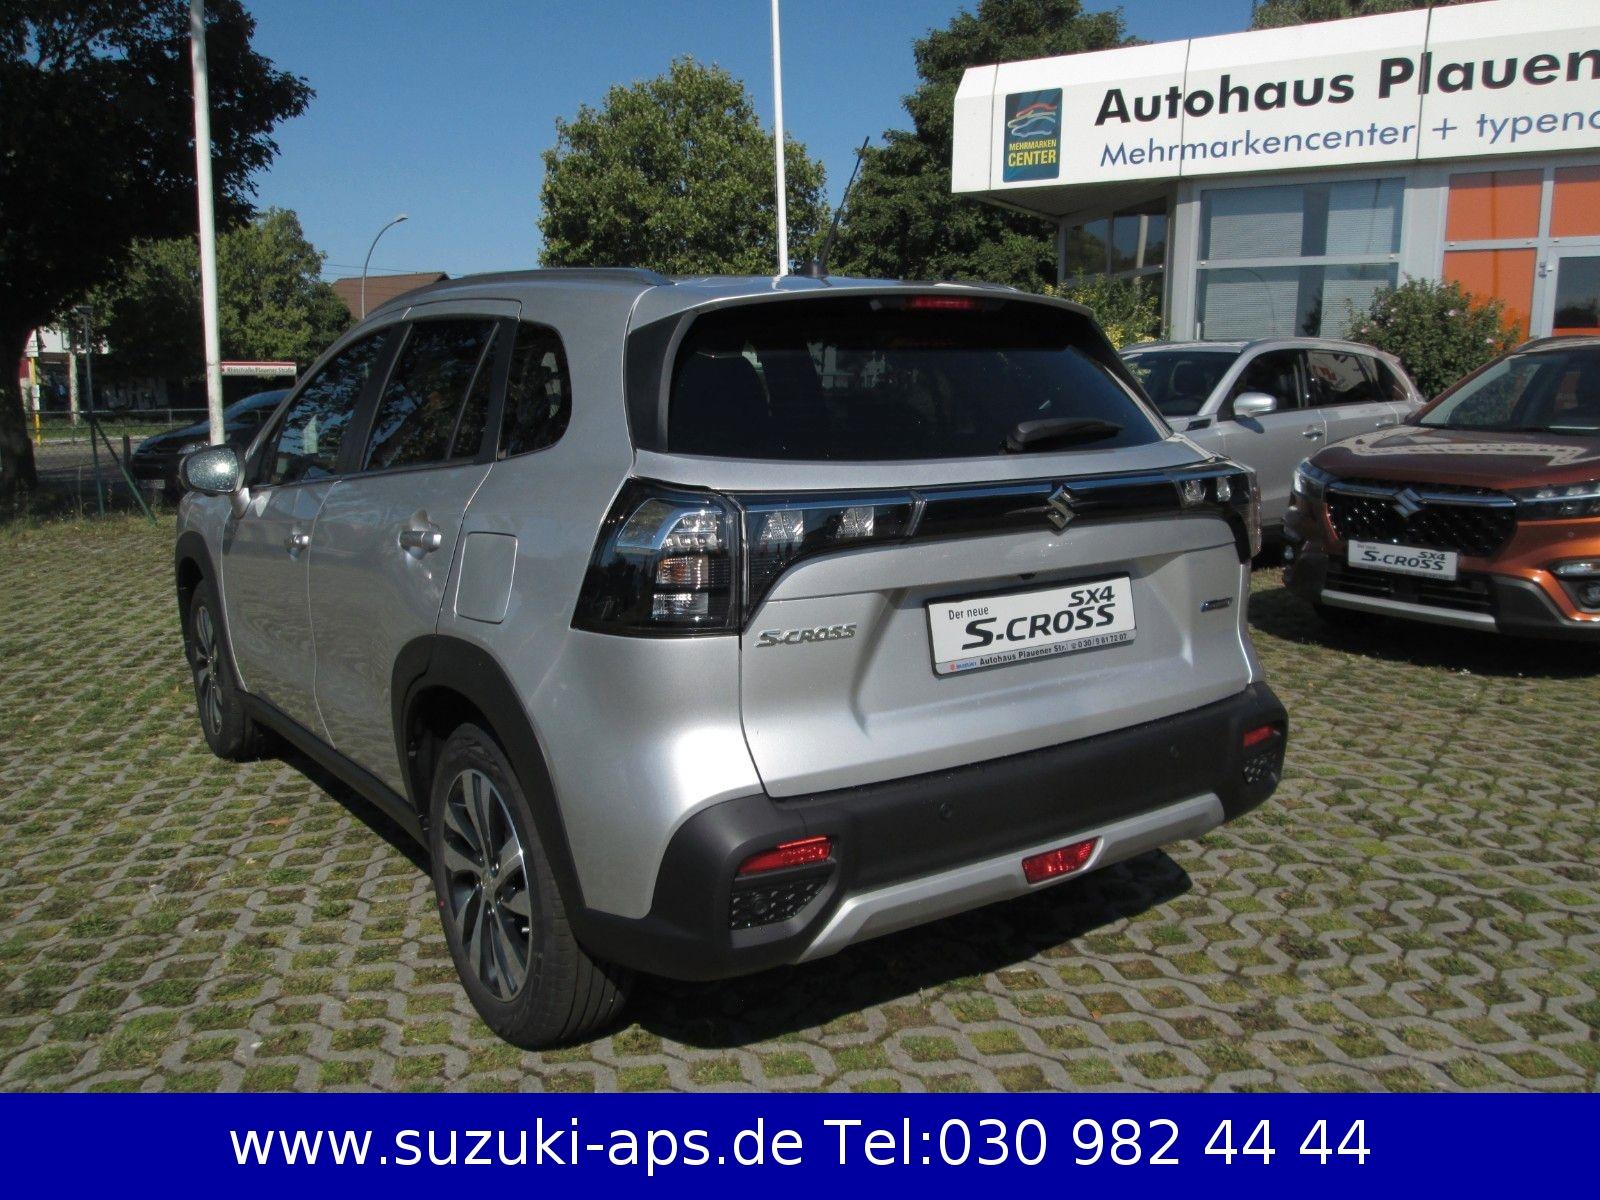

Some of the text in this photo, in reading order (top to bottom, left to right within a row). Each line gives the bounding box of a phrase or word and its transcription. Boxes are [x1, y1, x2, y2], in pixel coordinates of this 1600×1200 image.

[1094, 49, 1600, 127] Autohaus Plauen
[1009, 139, 1057, 151] MEHRMARKEN
[1100, 122, 1416, 167] Mehrmarkencenter
[1432, 118, 1458, 140] +
[1008, 149, 1057, 167] CENTER
[1418, 551, 1446, 560] SX4
[1068, 585, 1116, 608] SX4
[948, 606, 989, 621] Der neue
[980, 654, 1017, 666] Autohaus
[1018, 648, 1052, 659] Plauener
